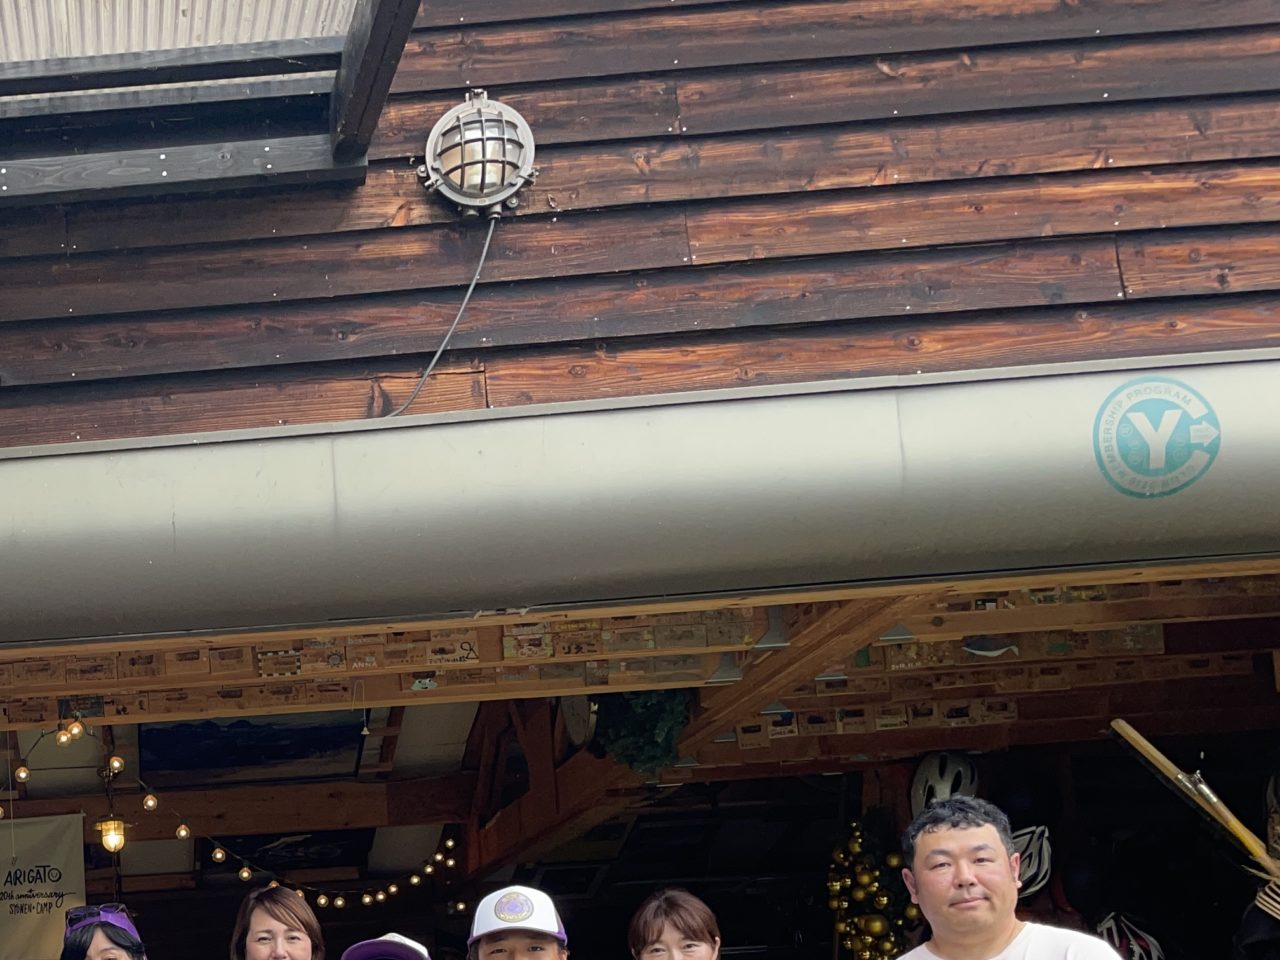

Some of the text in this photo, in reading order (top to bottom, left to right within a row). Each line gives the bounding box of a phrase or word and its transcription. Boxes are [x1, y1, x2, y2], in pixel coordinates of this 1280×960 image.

[4, 865, 62, 887] ARIGATO
[0, 891, 14, 901] 20th
[36, 902, 54, 915] CAMP
